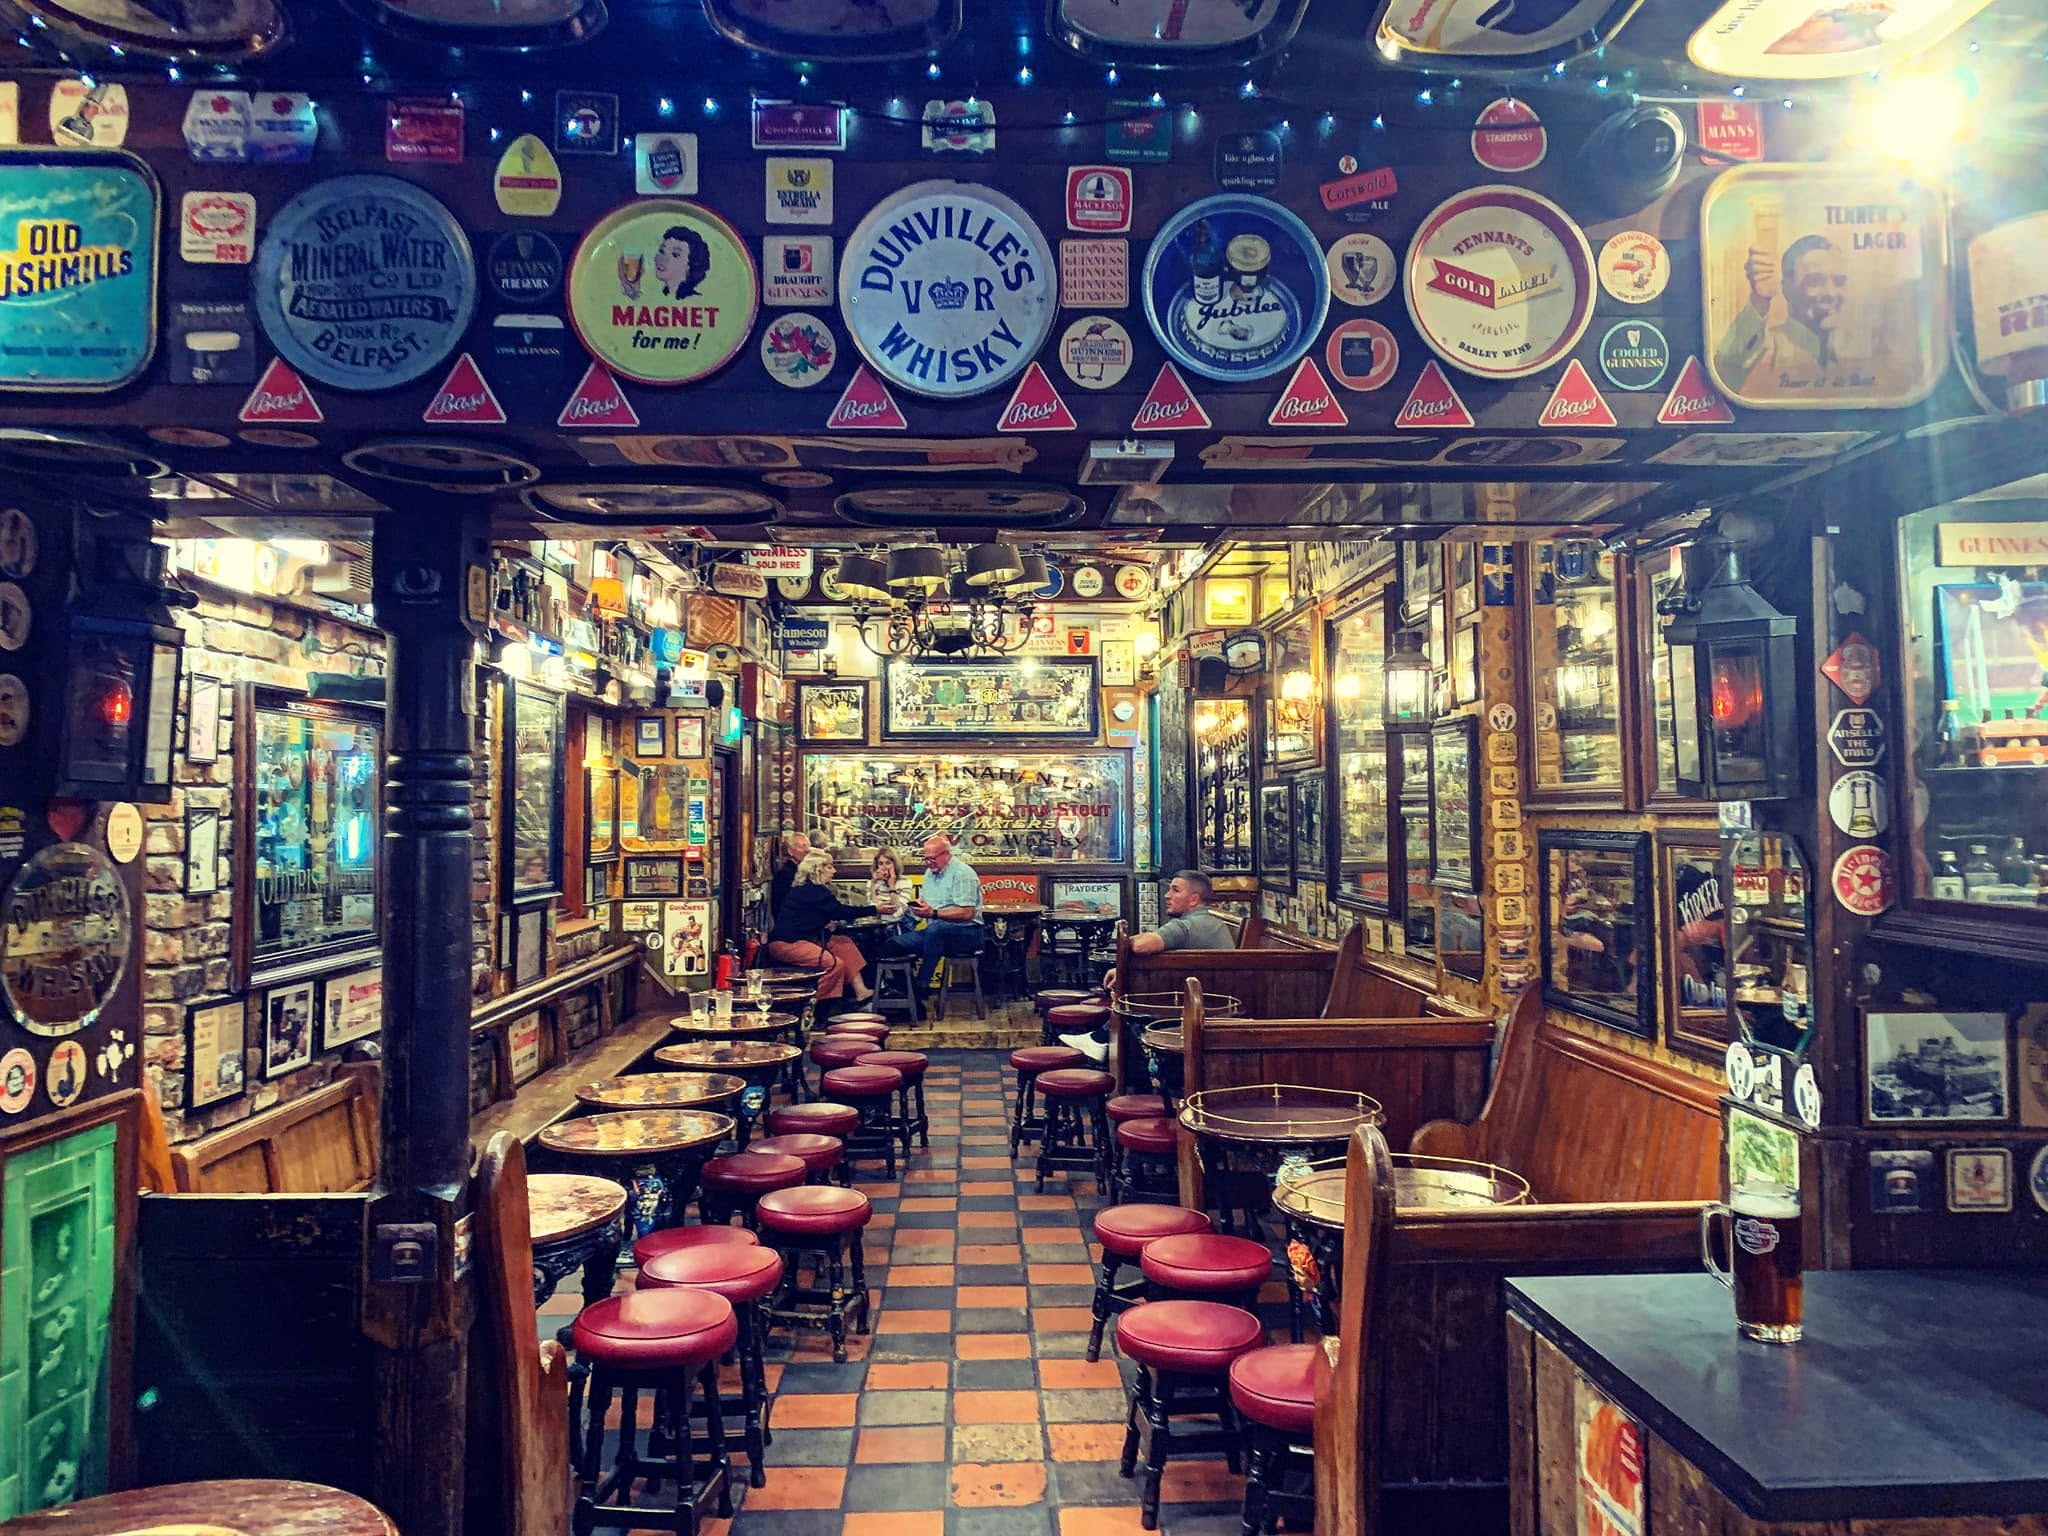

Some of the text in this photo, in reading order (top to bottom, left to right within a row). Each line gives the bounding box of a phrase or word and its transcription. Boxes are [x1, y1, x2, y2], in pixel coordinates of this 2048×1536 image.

[1708, 124, 1755, 139] MANNS
[1074, 200, 1125, 210] MACKESON
[1371, 201, 1389, 210] ALE
[316, 205, 420, 242] BELFAST
[29, 223, 82, 256] OLD
[1452, 231, 1535, 257] TENNANTS
[1853, 232, 1907, 250] LAGER
[292, 231, 447, 281] MINERAL WATER
[860, 205, 1035, 293] DUNVILLE'S
[1064, 244, 1124, 254] GUINNESS
[1064, 256, 1124, 266] GUINNESS
[773, 275, 823, 286] DRAUGHT
[1064, 268, 1124, 278] GUINNESS
[767, 286, 829, 299] GUINNESS
[1064, 279, 1124, 290] GUINNESS
[1444, 272, 1491, 298] GOLD
[900, 276, 996, 314] V R
[1064, 290, 1124, 301] GUINNESS
[611, 304, 720, 329] MAGNET
[1198, 297, 1282, 330] Jubilee
[335, 323, 375, 340] YORK
[631, 330, 661, 350] for
[878, 317, 1023, 383] WHISKY
[1070, 349, 1124, 357] GUINNESS
[1457, 340, 1533, 359] BARLEY WINE
[1612, 348, 1659, 359] COOLED
[1605, 357, 1664, 369] GUINNESS
[569, 393, 620, 420] Bass
[838, 399, 888, 422] Bass
[1008, 399, 1058, 423] Bass
[1141, 398, 1190, 424] Bass
[1281, 397, 1330, 419] Bass
[1405, 396, 1454, 421] Bass
[1549, 396, 1599, 420] Bass
[1669, 395, 1717, 417] Bass
[756, 560, 801, 569] SOLD HERE
[773, 623, 827, 639] Jameson
[1847, 739, 1869, 748] THE
[913, 768, 926, 780] &
[995, 802, 1049, 817] EXTRA
[1056, 802, 1112, 817] STOUT
[1203, 785, 1246, 828] PUG
[974, 818, 1057, 830] WATERS
[980, 879, 1037, 895] PROBYNS
